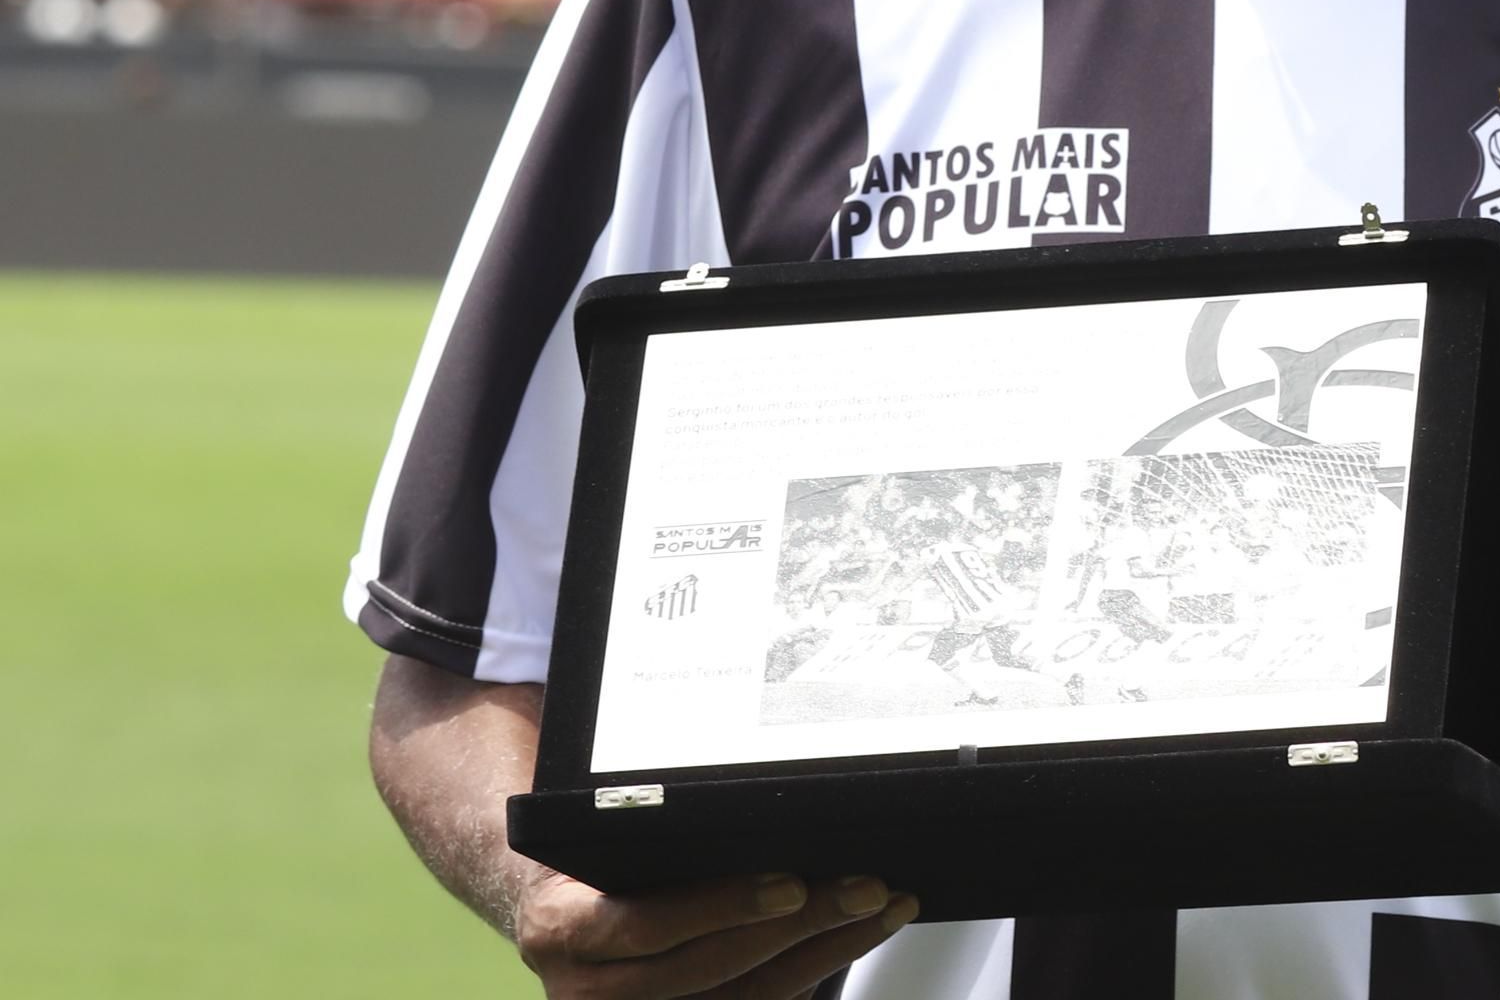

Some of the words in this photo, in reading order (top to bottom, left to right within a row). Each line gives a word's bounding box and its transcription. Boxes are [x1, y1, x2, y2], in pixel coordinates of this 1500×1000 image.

[851, 141, 995, 195] ANTOS
[1011, 132, 1122, 172] MAIS
[838, 173, 1123, 259] POPULAR
[653, 533, 762, 554] POPULAR
[656, 526, 715, 540] SANTOS
